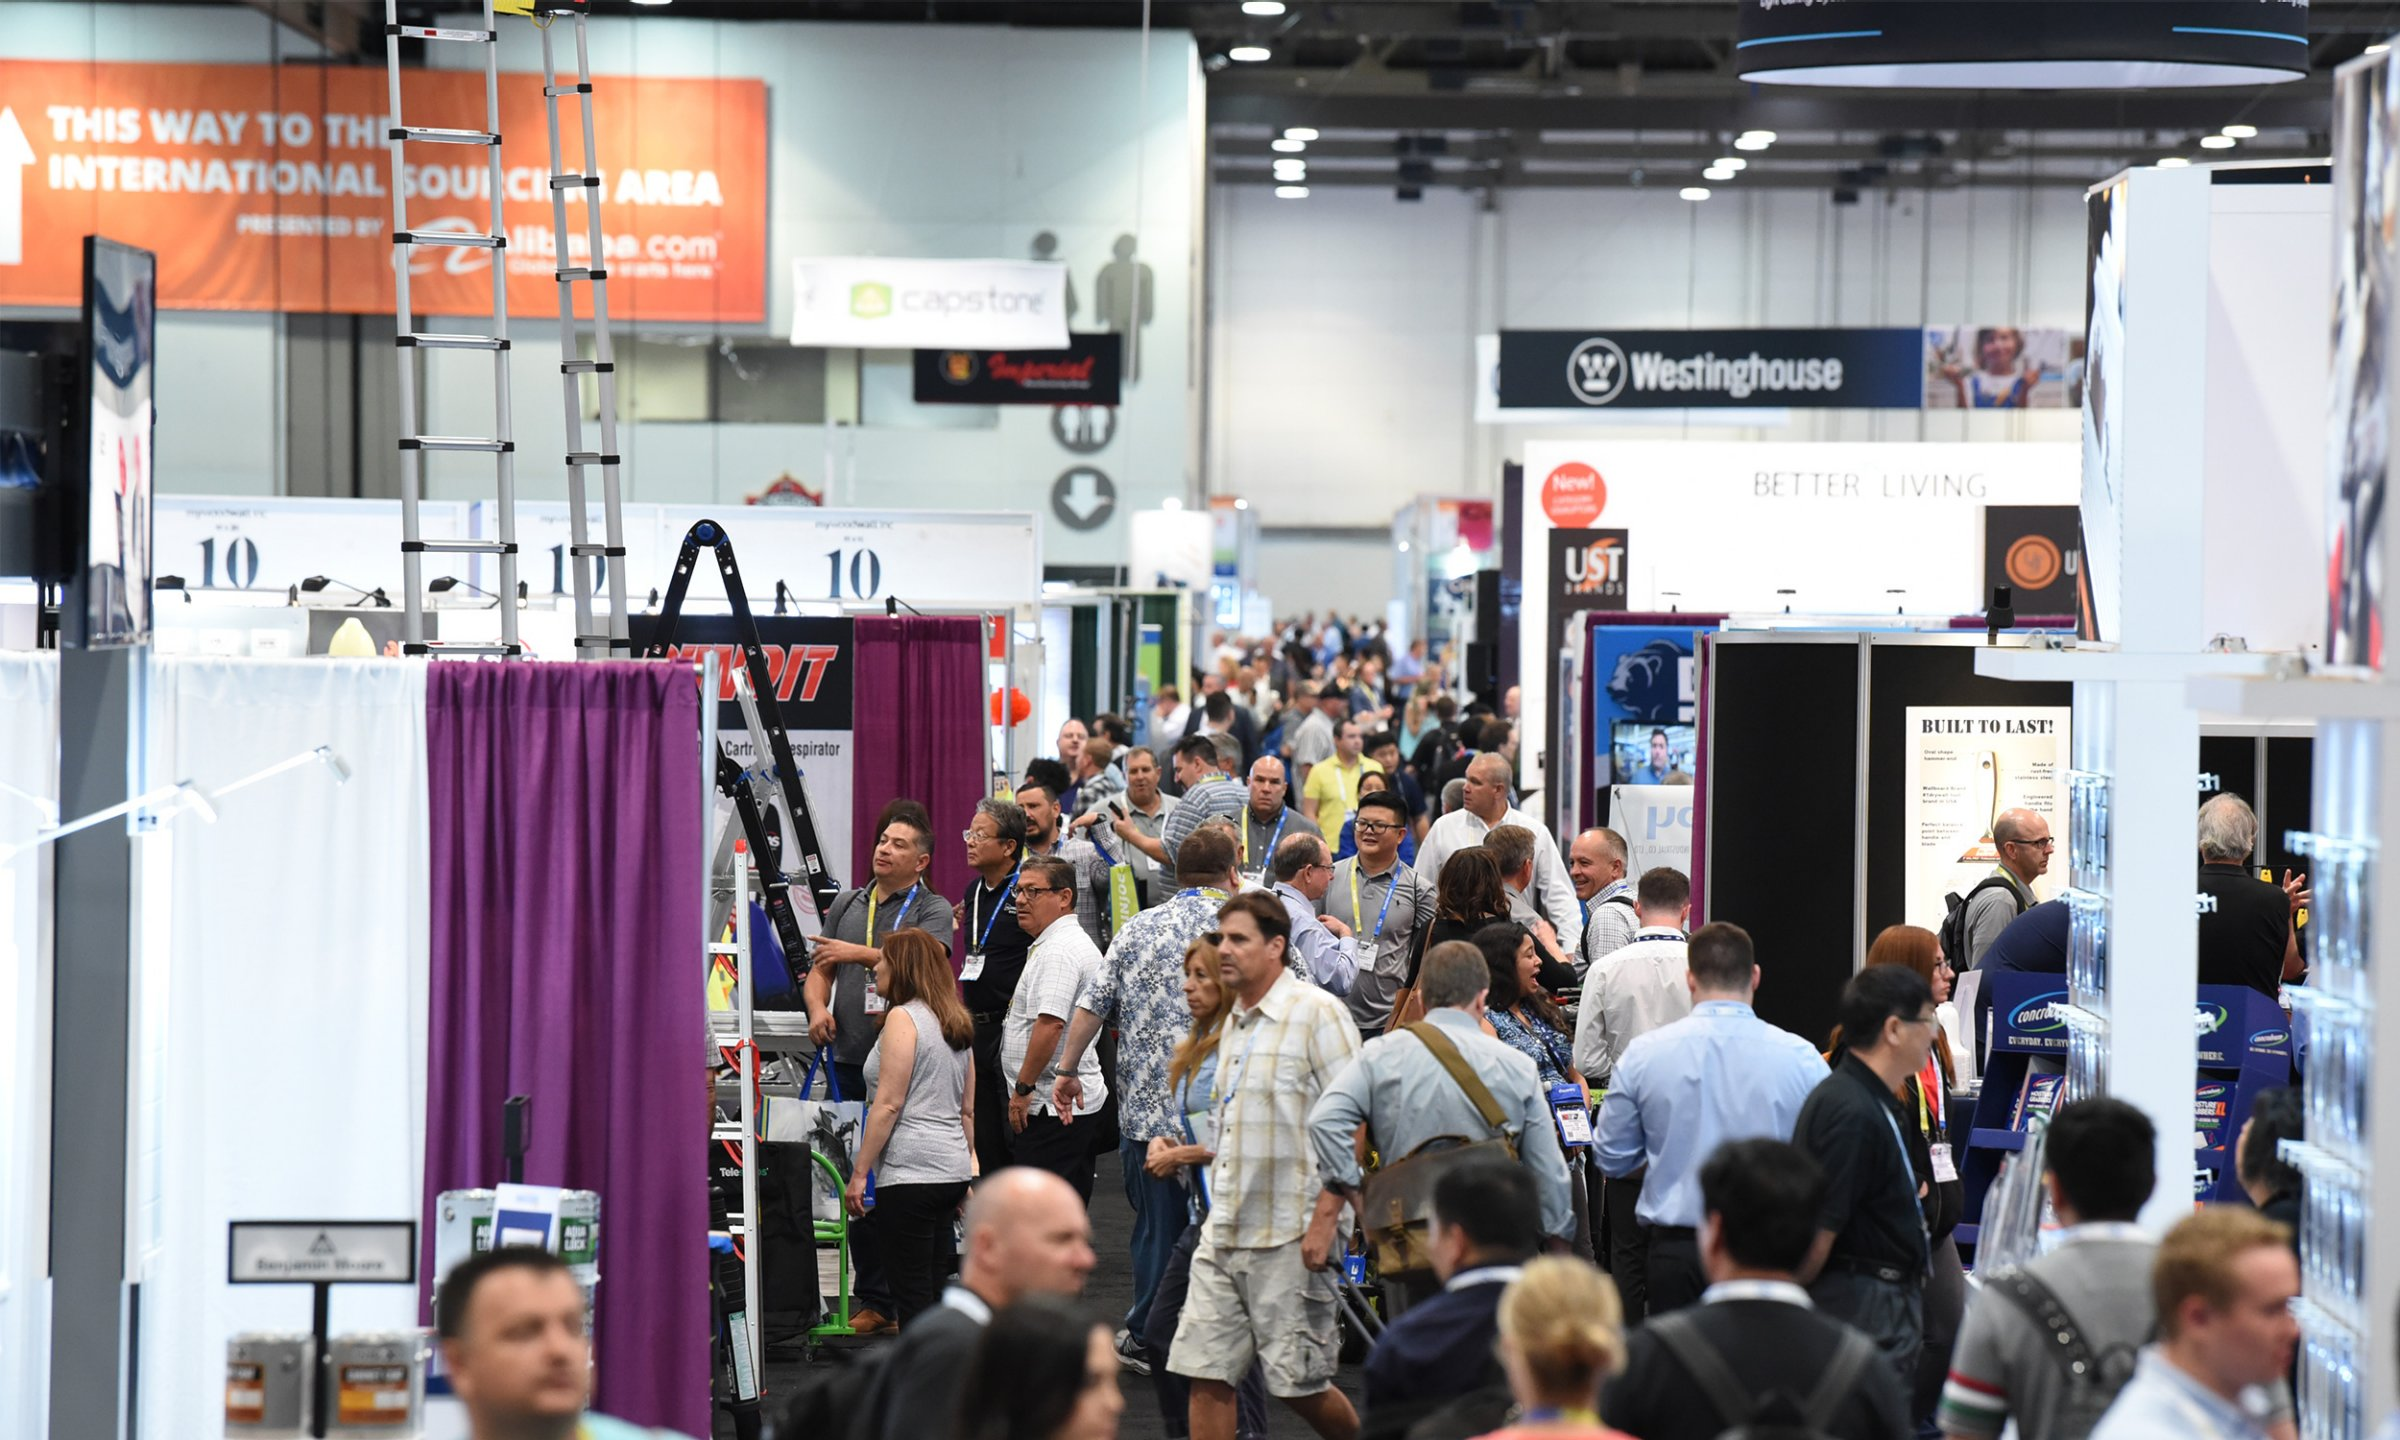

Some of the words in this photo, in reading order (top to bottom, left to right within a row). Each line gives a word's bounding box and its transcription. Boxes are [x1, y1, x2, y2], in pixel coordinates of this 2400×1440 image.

[48, 106, 141, 143] THIS
[151, 110, 248, 146] WAY
[258, 112, 313, 148] TO
[48, 153, 387, 198] INTERNATIONAL
[403, 164, 607, 203] SOUCIN
[615, 169, 723, 206] AREA
[236, 213, 351, 237] PRESENTED
[356, 217, 383, 238] BY
[902, 286, 1045, 317] capstone
[1630, 351, 1844, 399] Westinghouse
[1551, 472, 1596, 492] New!
[1753, 472, 1861, 497] BETTER
[1883, 472, 1987, 498] LIVING
[198, 537, 259, 589] 10
[823, 548, 881, 601] 10
[1565, 546, 1624, 582] UST
[1922, 719, 1974, 734] BUILT
[1978, 719, 2001, 734] TO
[2006, 719, 2054, 734] LAST!
[789, 740, 841, 759] espirator
[564, 1225, 588, 1238] AQUA
[564, 1238, 588, 1252] LOCK
